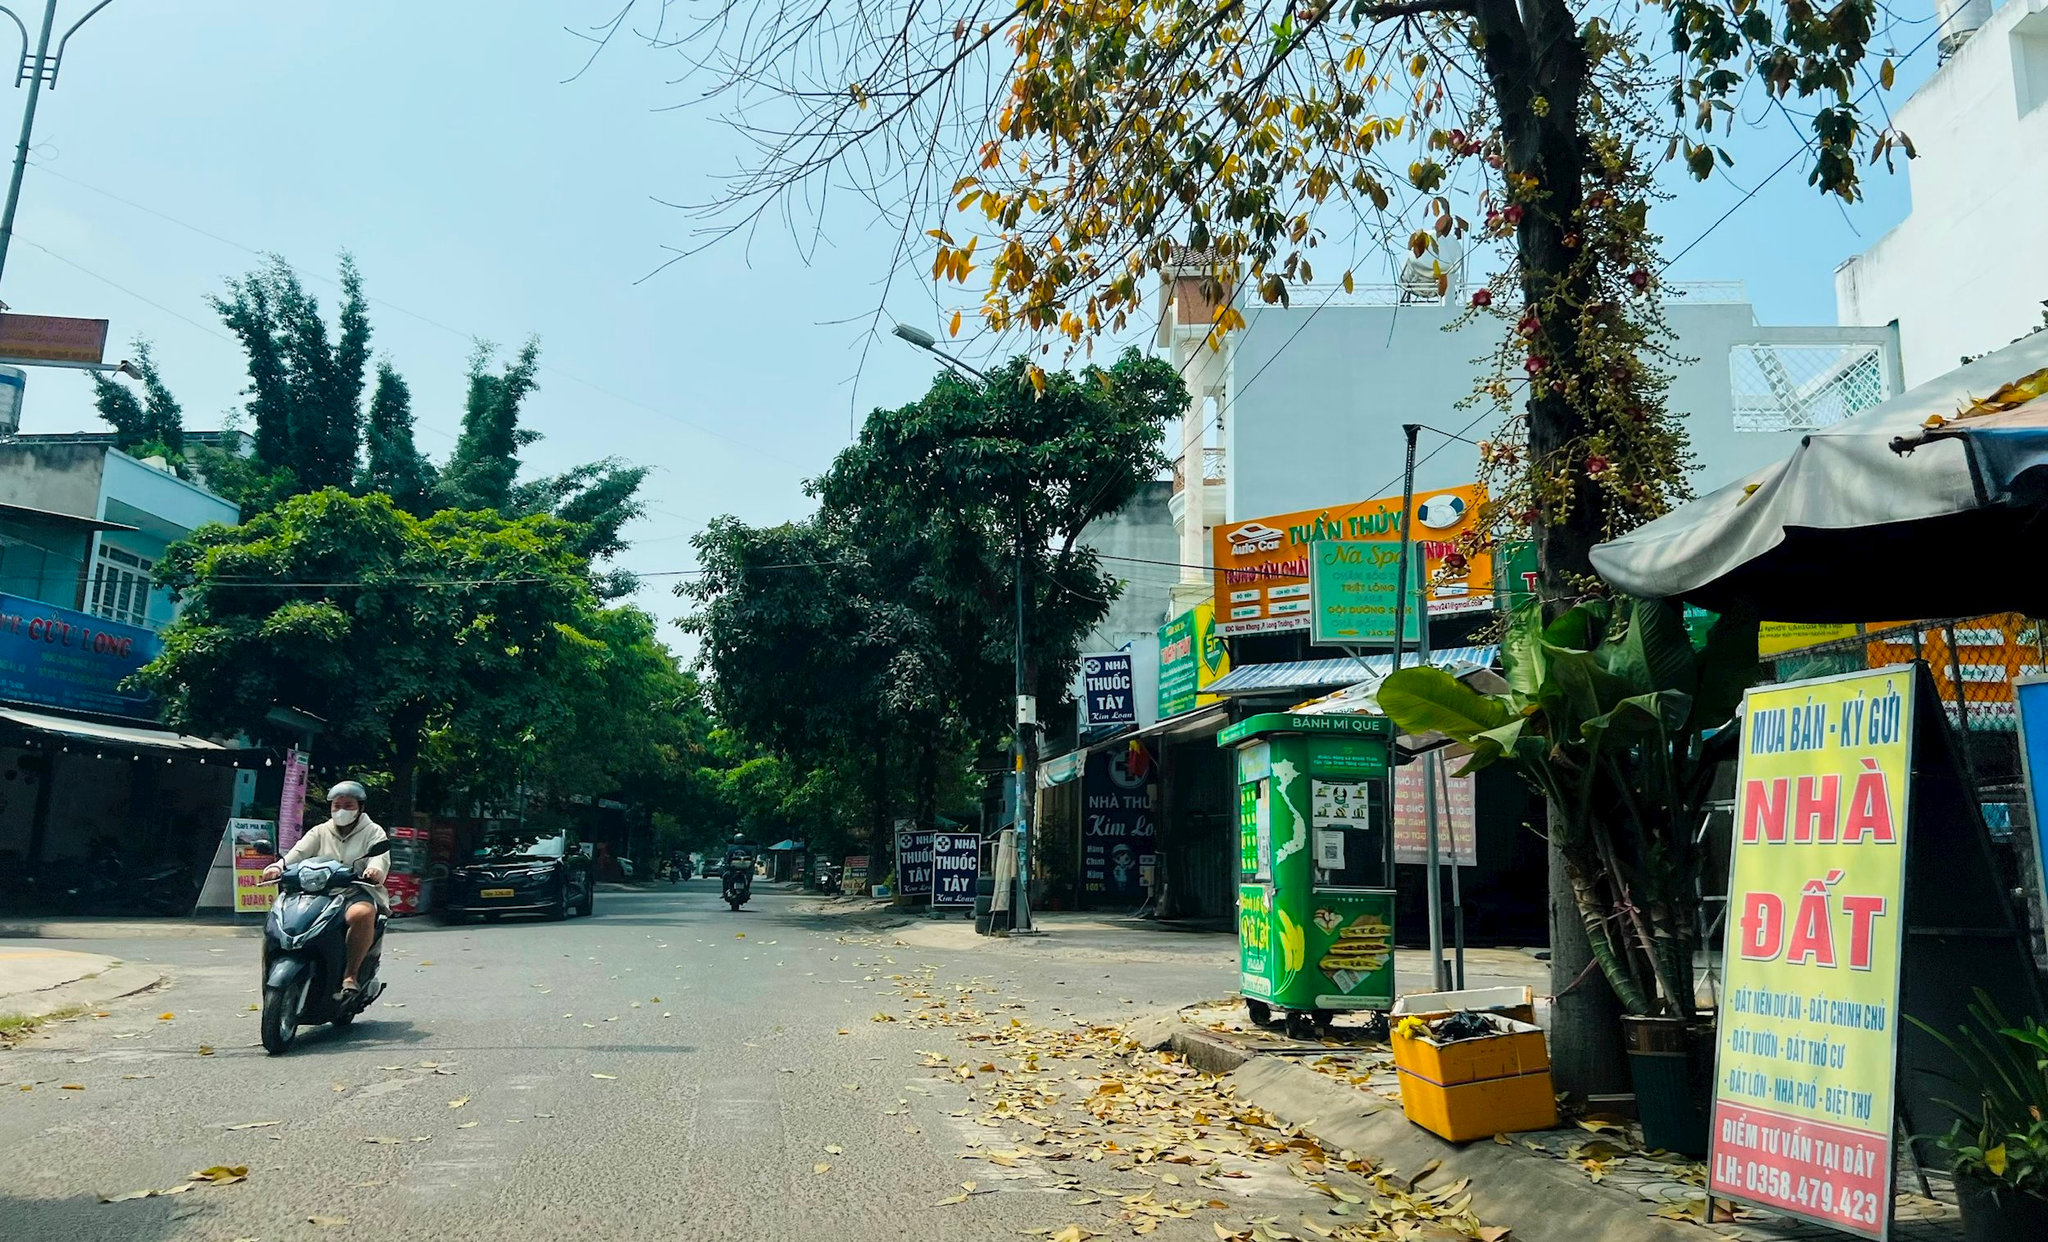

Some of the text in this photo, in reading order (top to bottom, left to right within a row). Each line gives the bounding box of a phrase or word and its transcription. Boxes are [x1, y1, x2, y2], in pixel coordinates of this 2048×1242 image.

[1231, 540, 1280, 556] Auto Car
[1323, 545, 1362, 566] Na
[1104, 658, 1129, 671] NHÀ
[1086, 671, 1131, 692] THUỐC
[1096, 694, 1125, 710] TÂY
[1090, 711, 1133, 721] Kim Loan
[1292, 716, 1330, 728] BÁNH
[1352, 719, 1380, 732] QUE
[1751, 680, 1901, 755] MUA BÁN KÝ GỬI
[1089, 792, 1152, 809] NHÀ THU
[1742, 756, 1897, 845] NHÀ
[1086, 814, 1154, 837] Kim Lo
[915, 833, 934, 846] NHÀ
[954, 837, 977, 850] NHÀ
[935, 851, 977, 871] THUỐC
[908, 866, 931, 883] TÂY
[942, 873, 970, 892] TÂY
[935, 893, 953, 903] Kim
[1740, 868, 1887, 972] ĐẤT
[1735, 983, 1886, 1032] ĐẤT NỀN DỰ ÁN ĐẤT CHÍNH CHỦ
[1732, 1026, 1846, 1070] ĐẤT VƯỜN ĐẤT THỔ CƯ
[1729, 1063, 1873, 1126] ĐẤT LỚN NHÀ PHỐ BIỆT THỰ
[1722, 1112, 1876, 1179] ĐIỂM TƯ VẤN TẠI ĐÂY
[1715, 1152, 1878, 1225] LH: 0358.479.423
